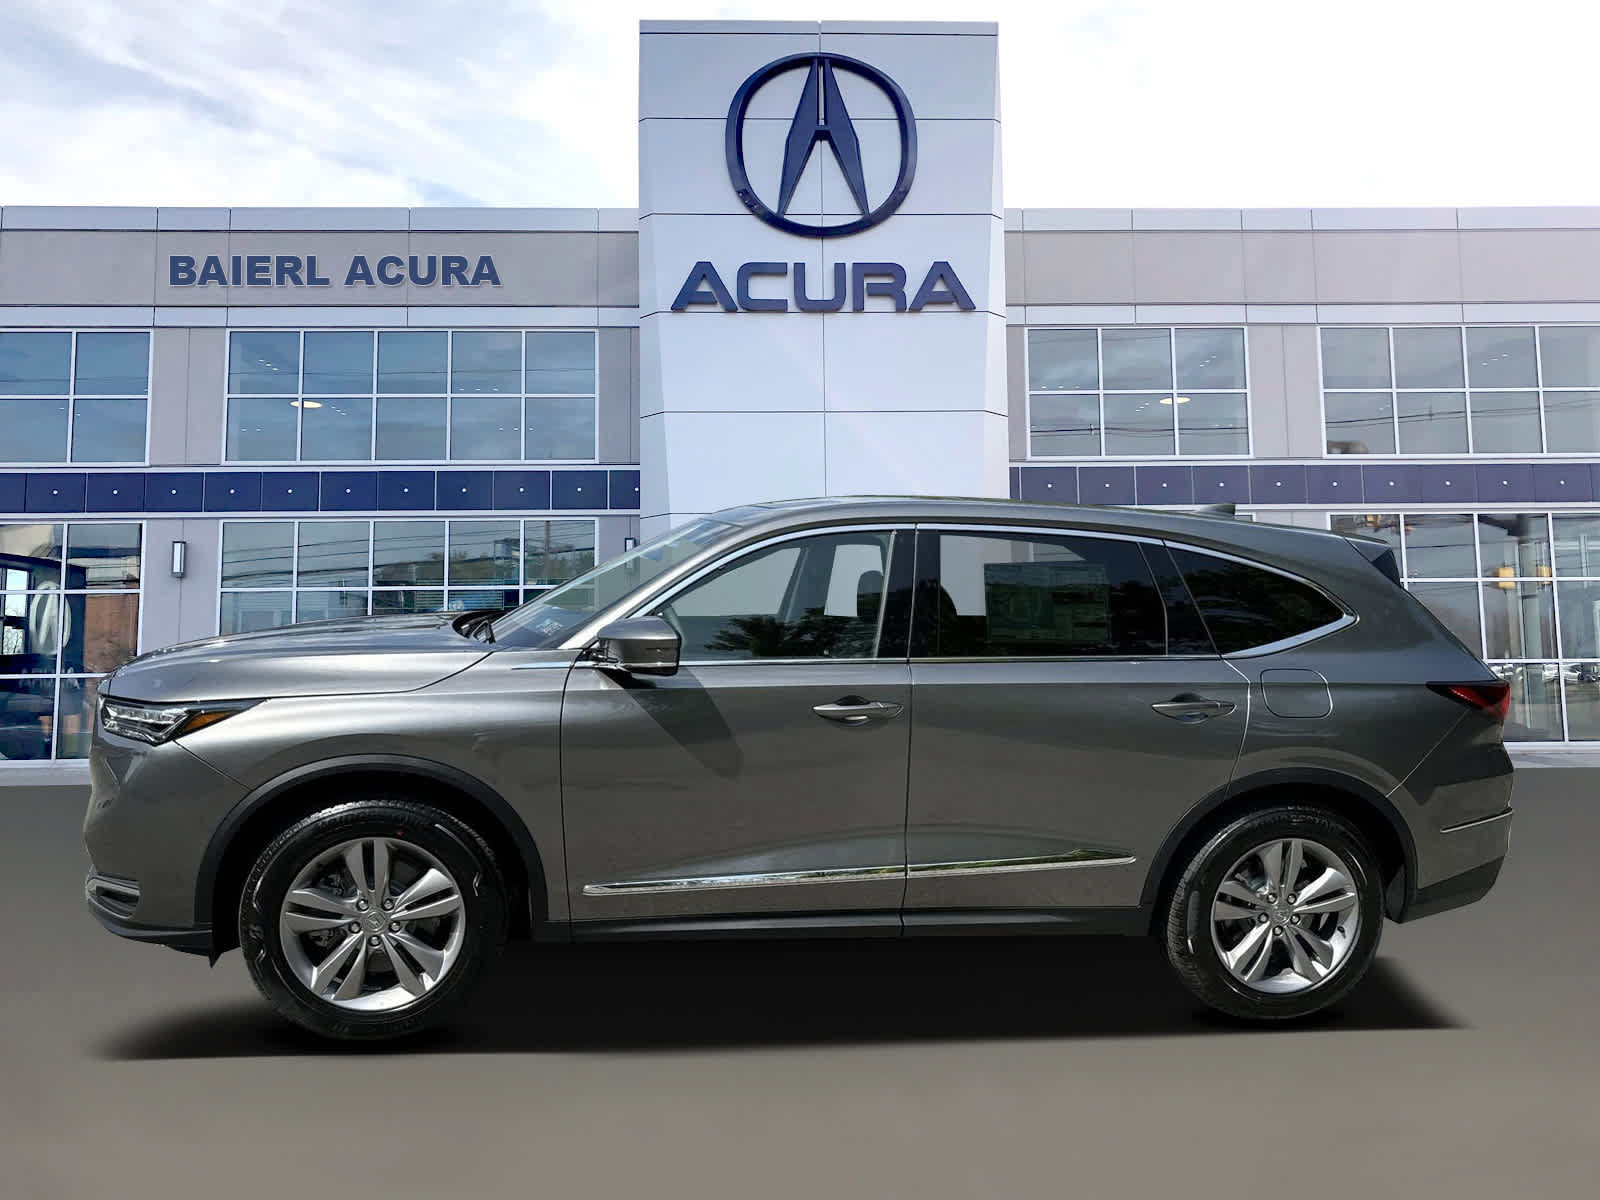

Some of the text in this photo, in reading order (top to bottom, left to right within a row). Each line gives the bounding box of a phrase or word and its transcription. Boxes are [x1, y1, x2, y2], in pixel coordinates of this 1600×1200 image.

[169, 255, 503, 287] BAIERL ACURA
[670, 261, 977, 312] ACURA
